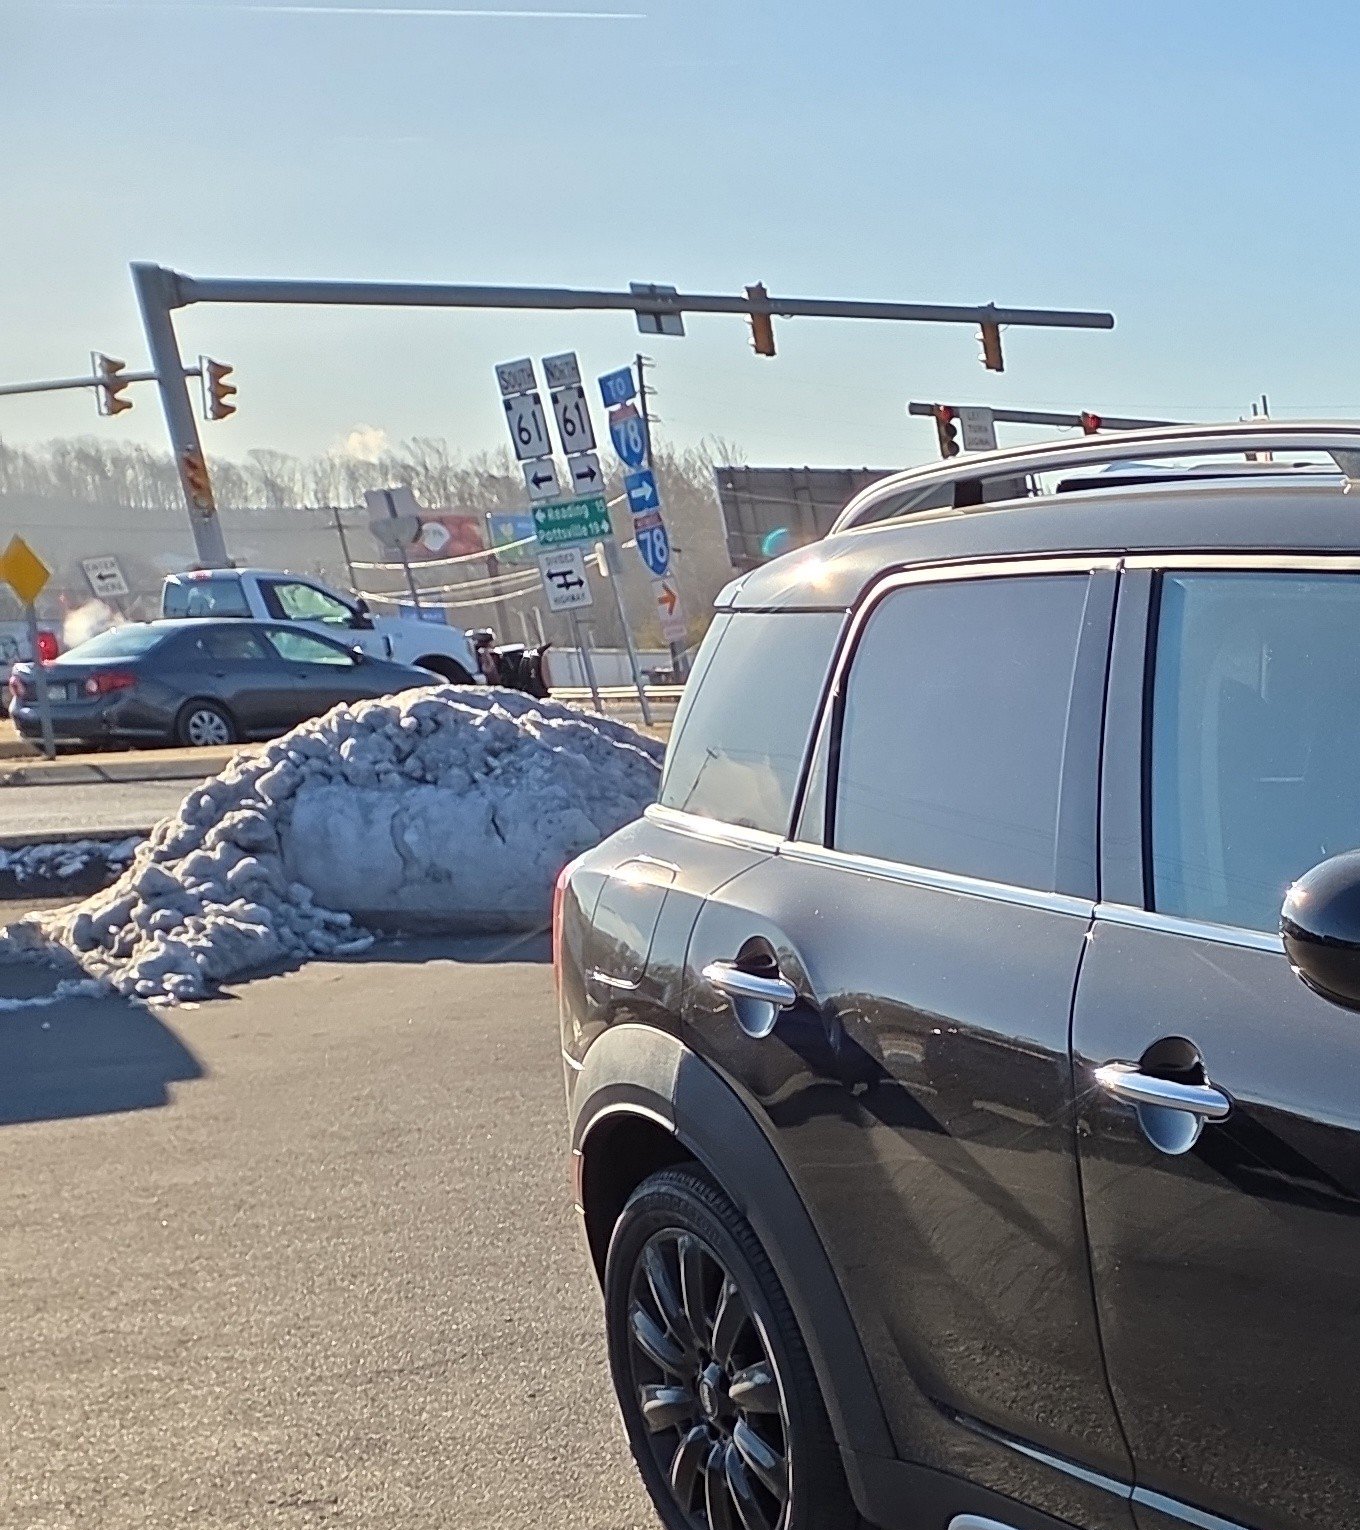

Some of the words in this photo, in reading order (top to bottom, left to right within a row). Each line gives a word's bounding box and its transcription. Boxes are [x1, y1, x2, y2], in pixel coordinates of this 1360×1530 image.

[606, 377, 626, 397] TO
[517, 409, 543, 446] 61
[563, 401, 586, 437] 61
[612, 419, 643, 458] 78
[547, 503, 589, 520] Reading
[637, 528, 667, 568] 78
